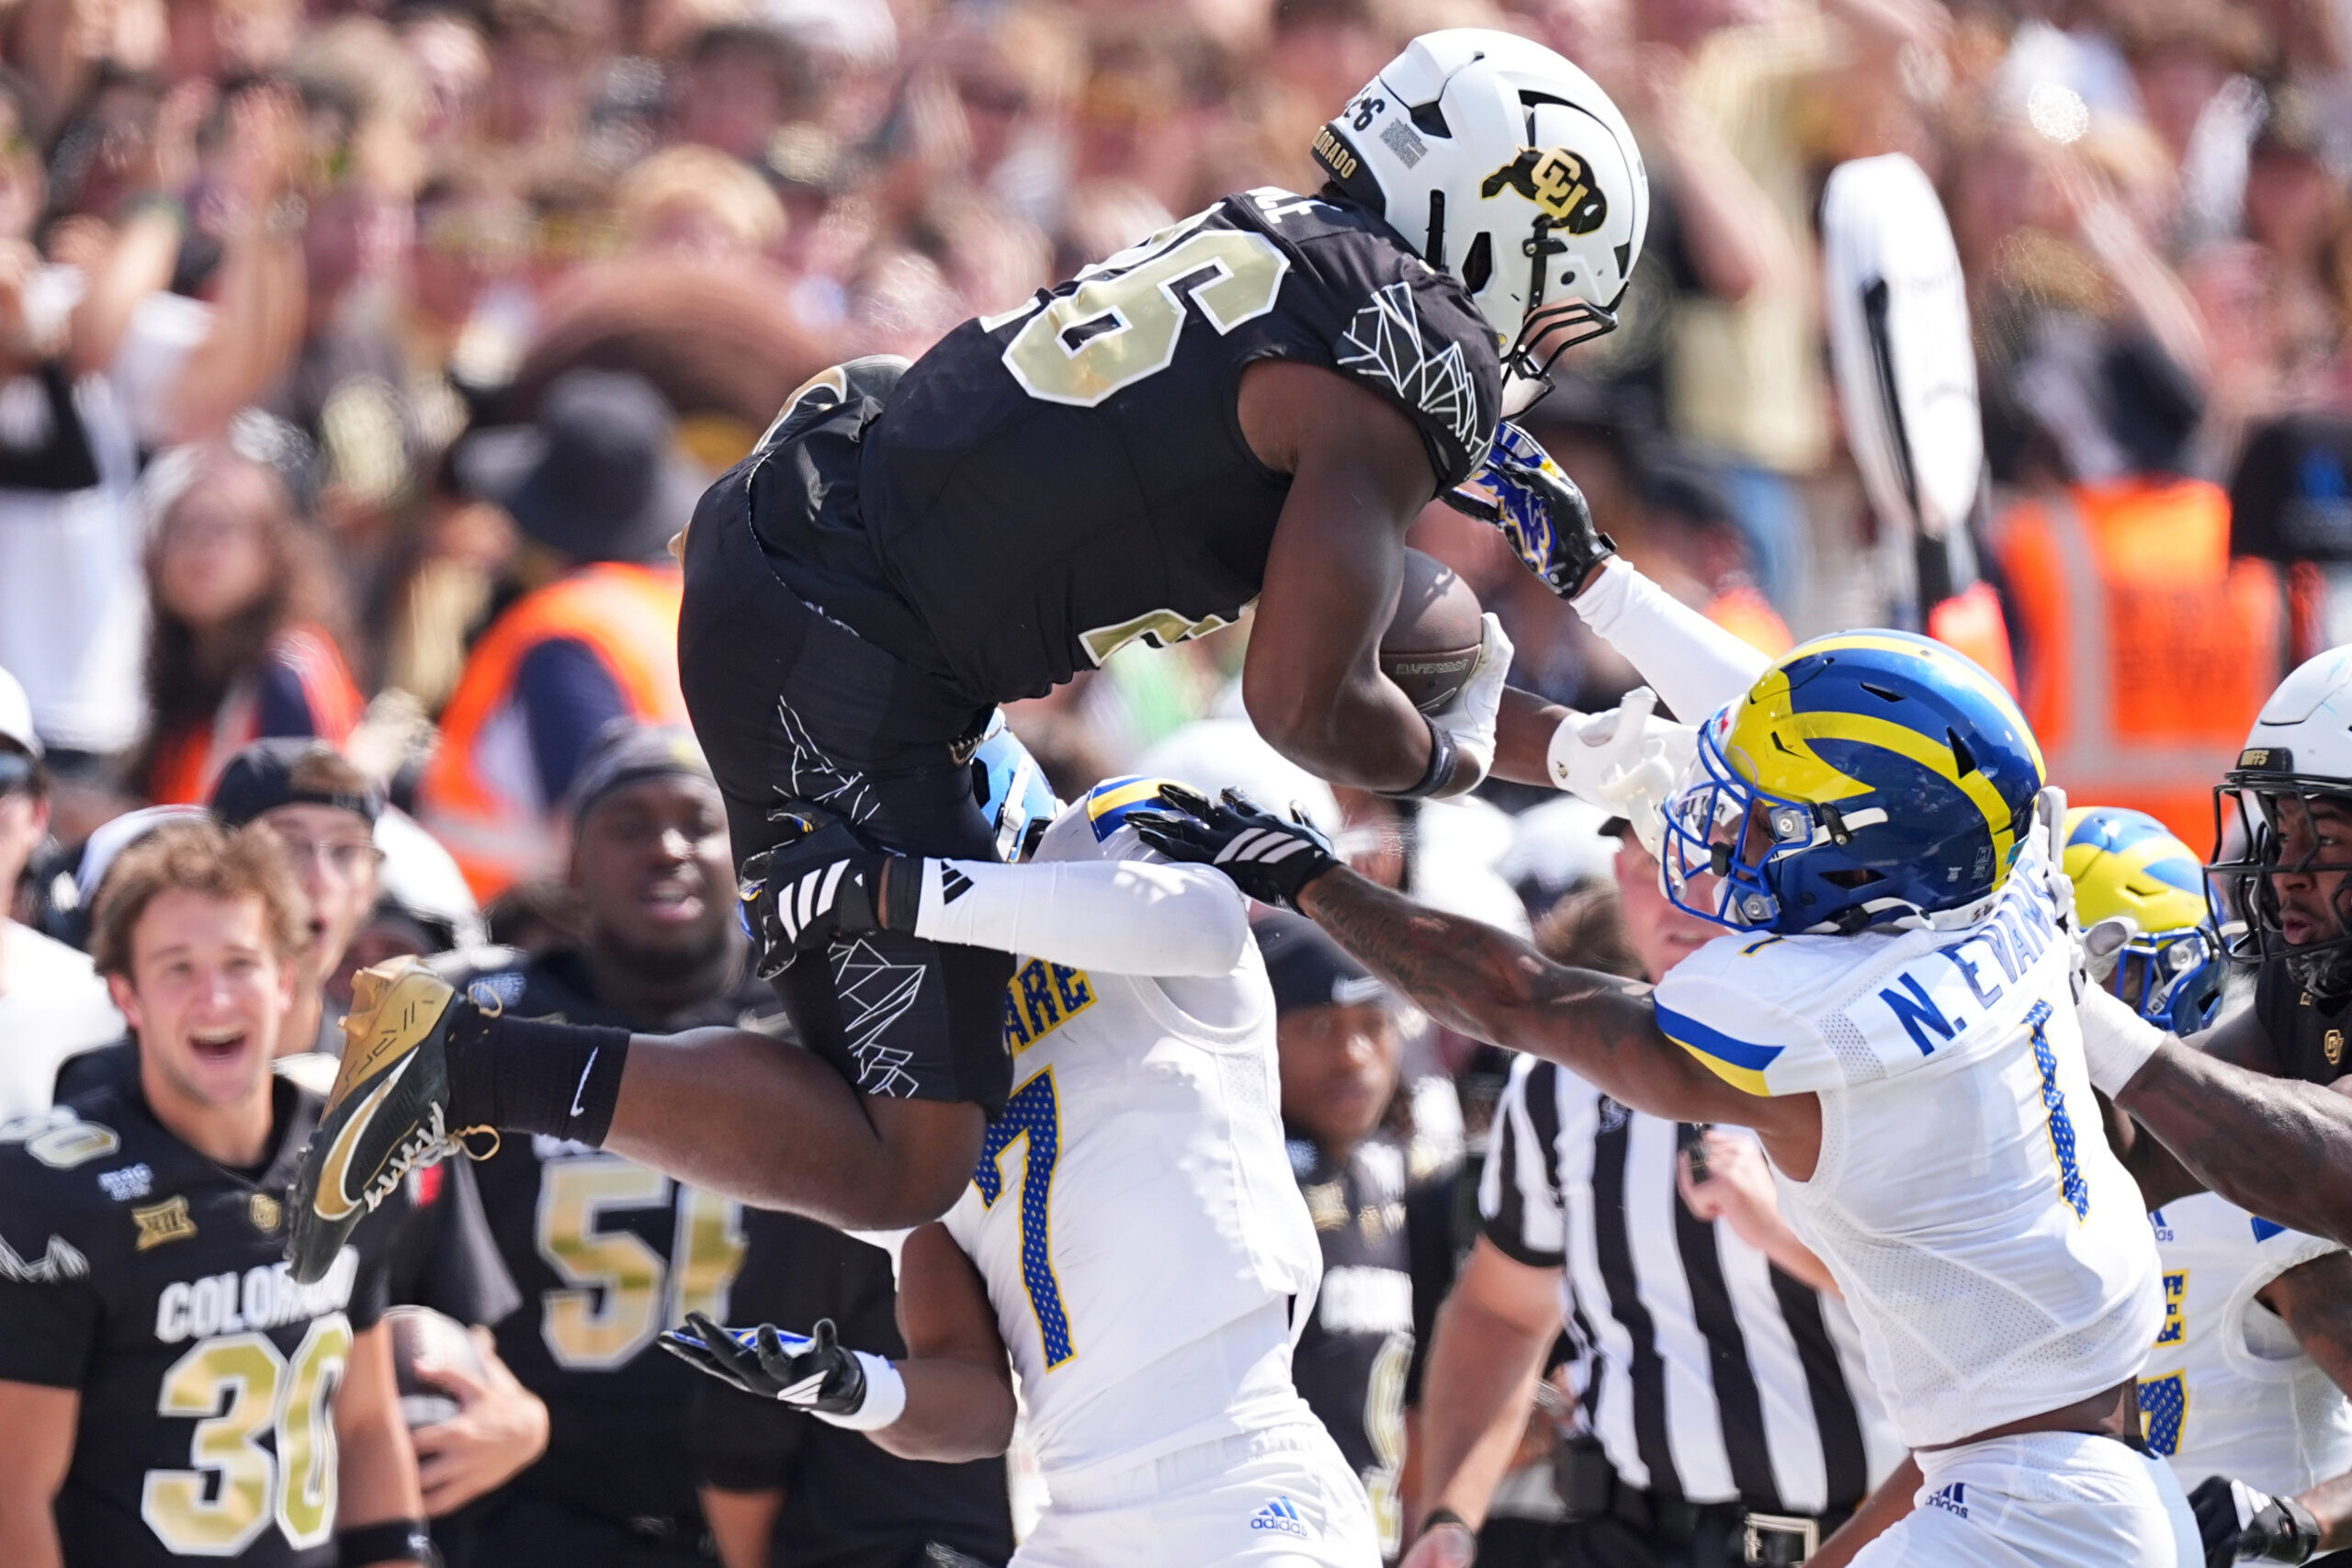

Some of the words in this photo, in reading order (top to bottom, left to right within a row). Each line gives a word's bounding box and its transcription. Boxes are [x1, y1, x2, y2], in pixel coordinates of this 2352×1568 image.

[980, 200, 1291, 407] 6
[1878, 972, 1968, 1057] N.
[2020, 998, 2090, 1226] 1
[973, 1063, 1078, 1375] 7
[141, 1311, 354, 1555] 30
[1250, 1516, 1307, 1537] adidas
